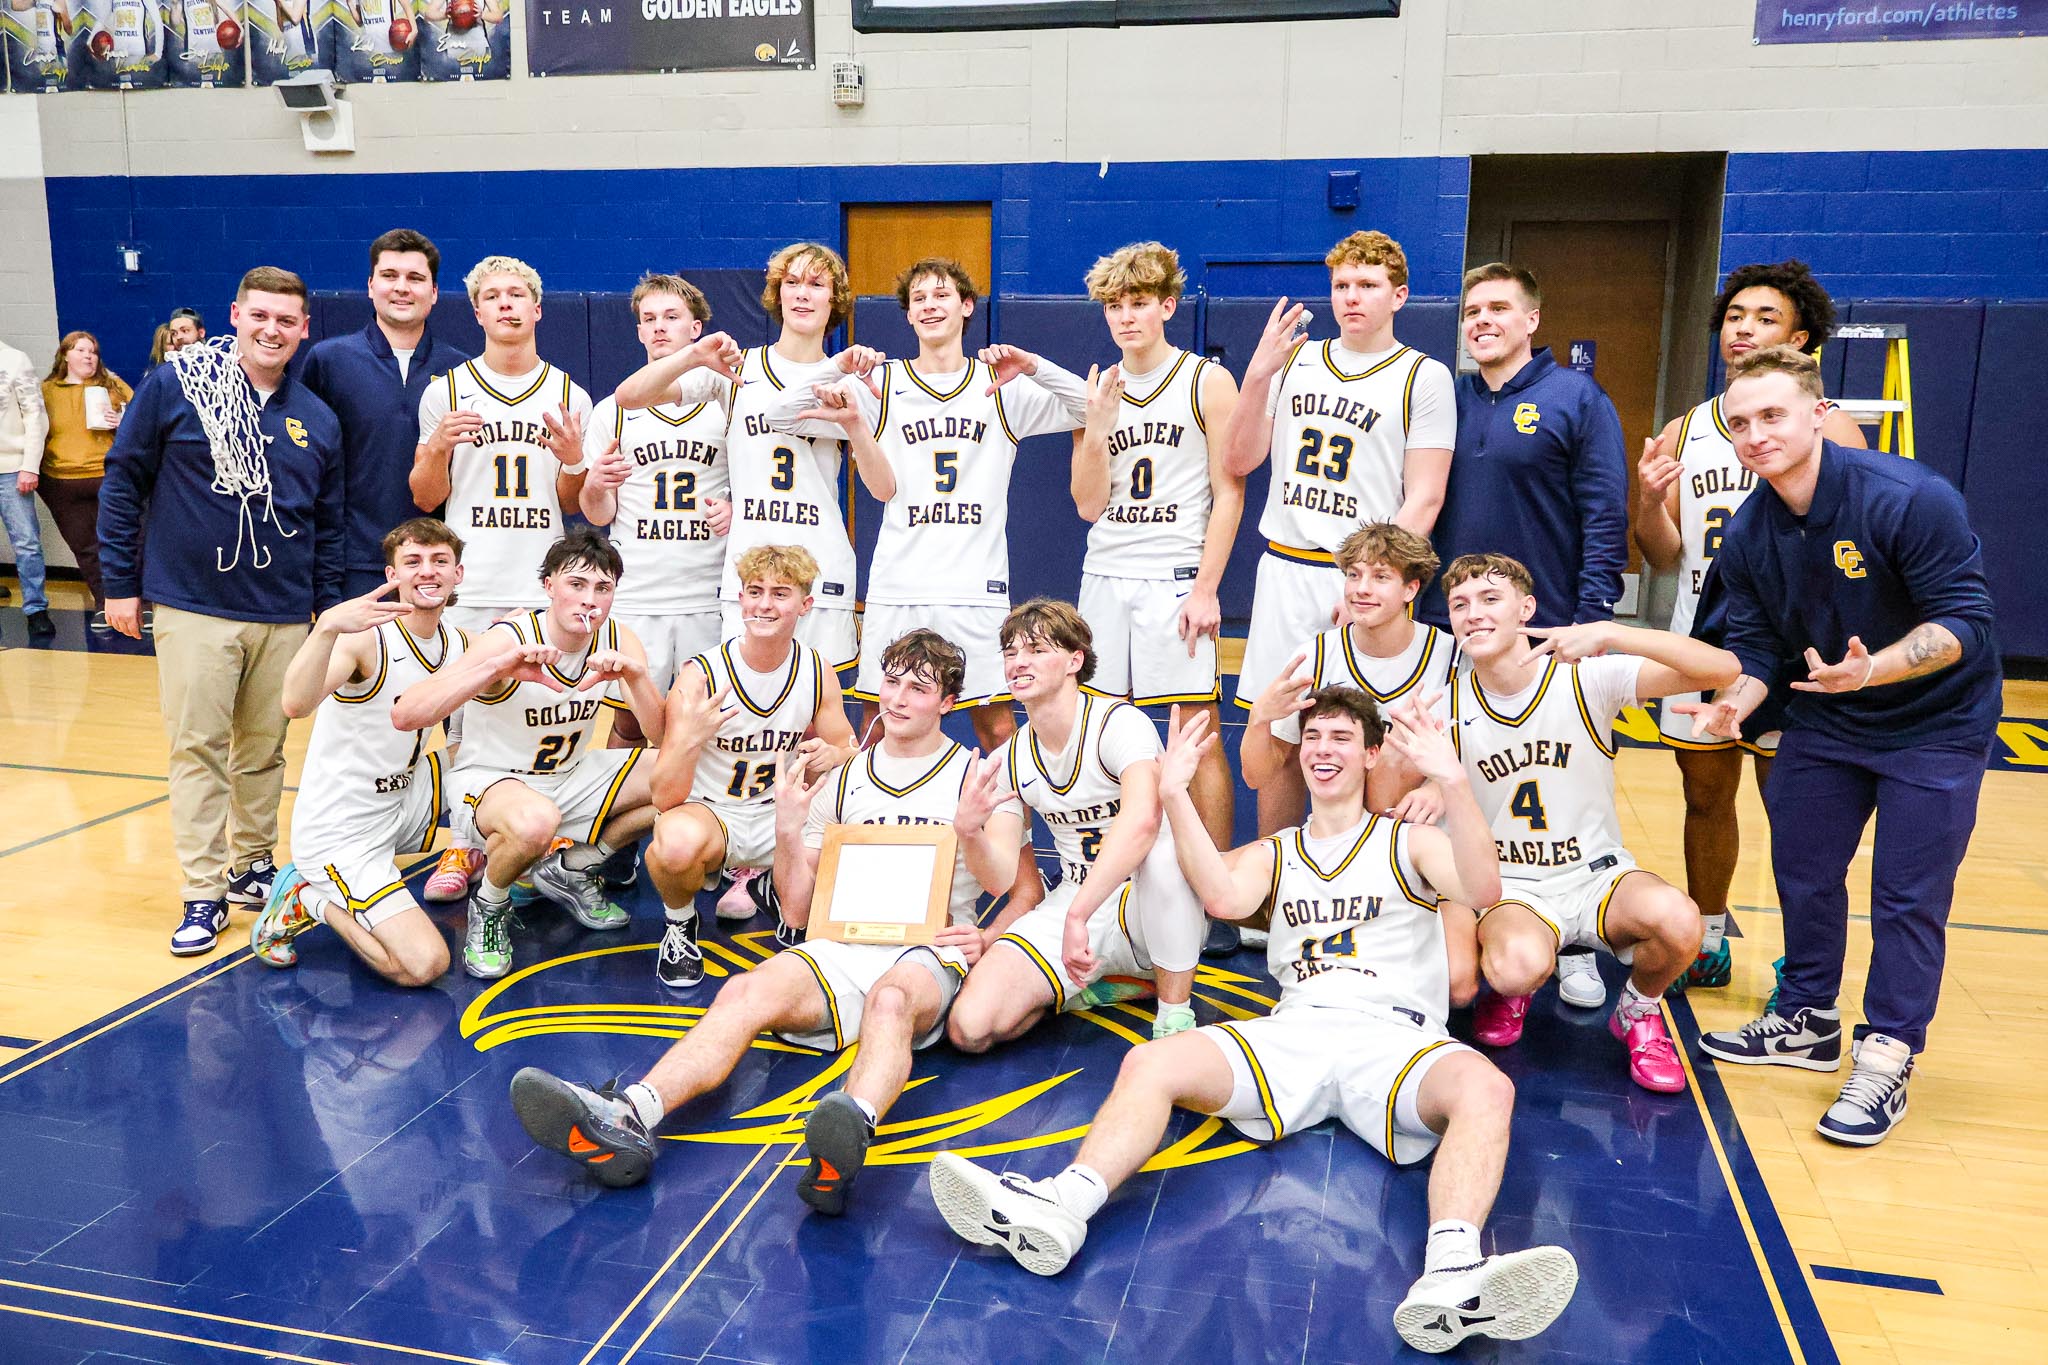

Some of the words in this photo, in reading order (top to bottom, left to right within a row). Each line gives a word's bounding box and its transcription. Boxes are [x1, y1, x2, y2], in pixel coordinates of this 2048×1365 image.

[543, 9, 612, 25] TEAM
[642, 0, 722, 20] GOLDEN
[728, 0, 803, 17] EAGLES
[1781, 3, 2018, 31] henryford.com/athletes
[1291, 393, 1381, 433] GOLDEN
[902, 416, 987, 445] GOLDEN
[1108, 422, 1184, 456] GOLDEN
[634, 440, 718, 467] GOLDEN
[770, 446, 794, 492] 3
[1295, 426, 1355, 483] 23
[493, 453, 530, 498] 11
[933, 450, 958, 493] 5
[1130, 456, 1153, 500] 0
[1691, 466, 1754, 499] GOLD
[654, 471, 696, 512] 12
[1283, 481, 1358, 519] EAGLES
[472, 507, 550, 529] EAGLES
[743, 499, 820, 526] EAGLES
[908, 502, 982, 527] EAGLES
[1106, 504, 1178, 524] EAGLES
[637, 520, 711, 541] EAGLES
[532, 729, 583, 771] 21
[716, 729, 803, 753] GOLDEN
[727, 757, 777, 799] 13
[1477, 740, 1572, 783] GOLDEN
[1508, 778, 1549, 832] 4
[1494, 836, 1582, 867] EAGLES
[1282, 895, 1383, 928] GOLDEN
